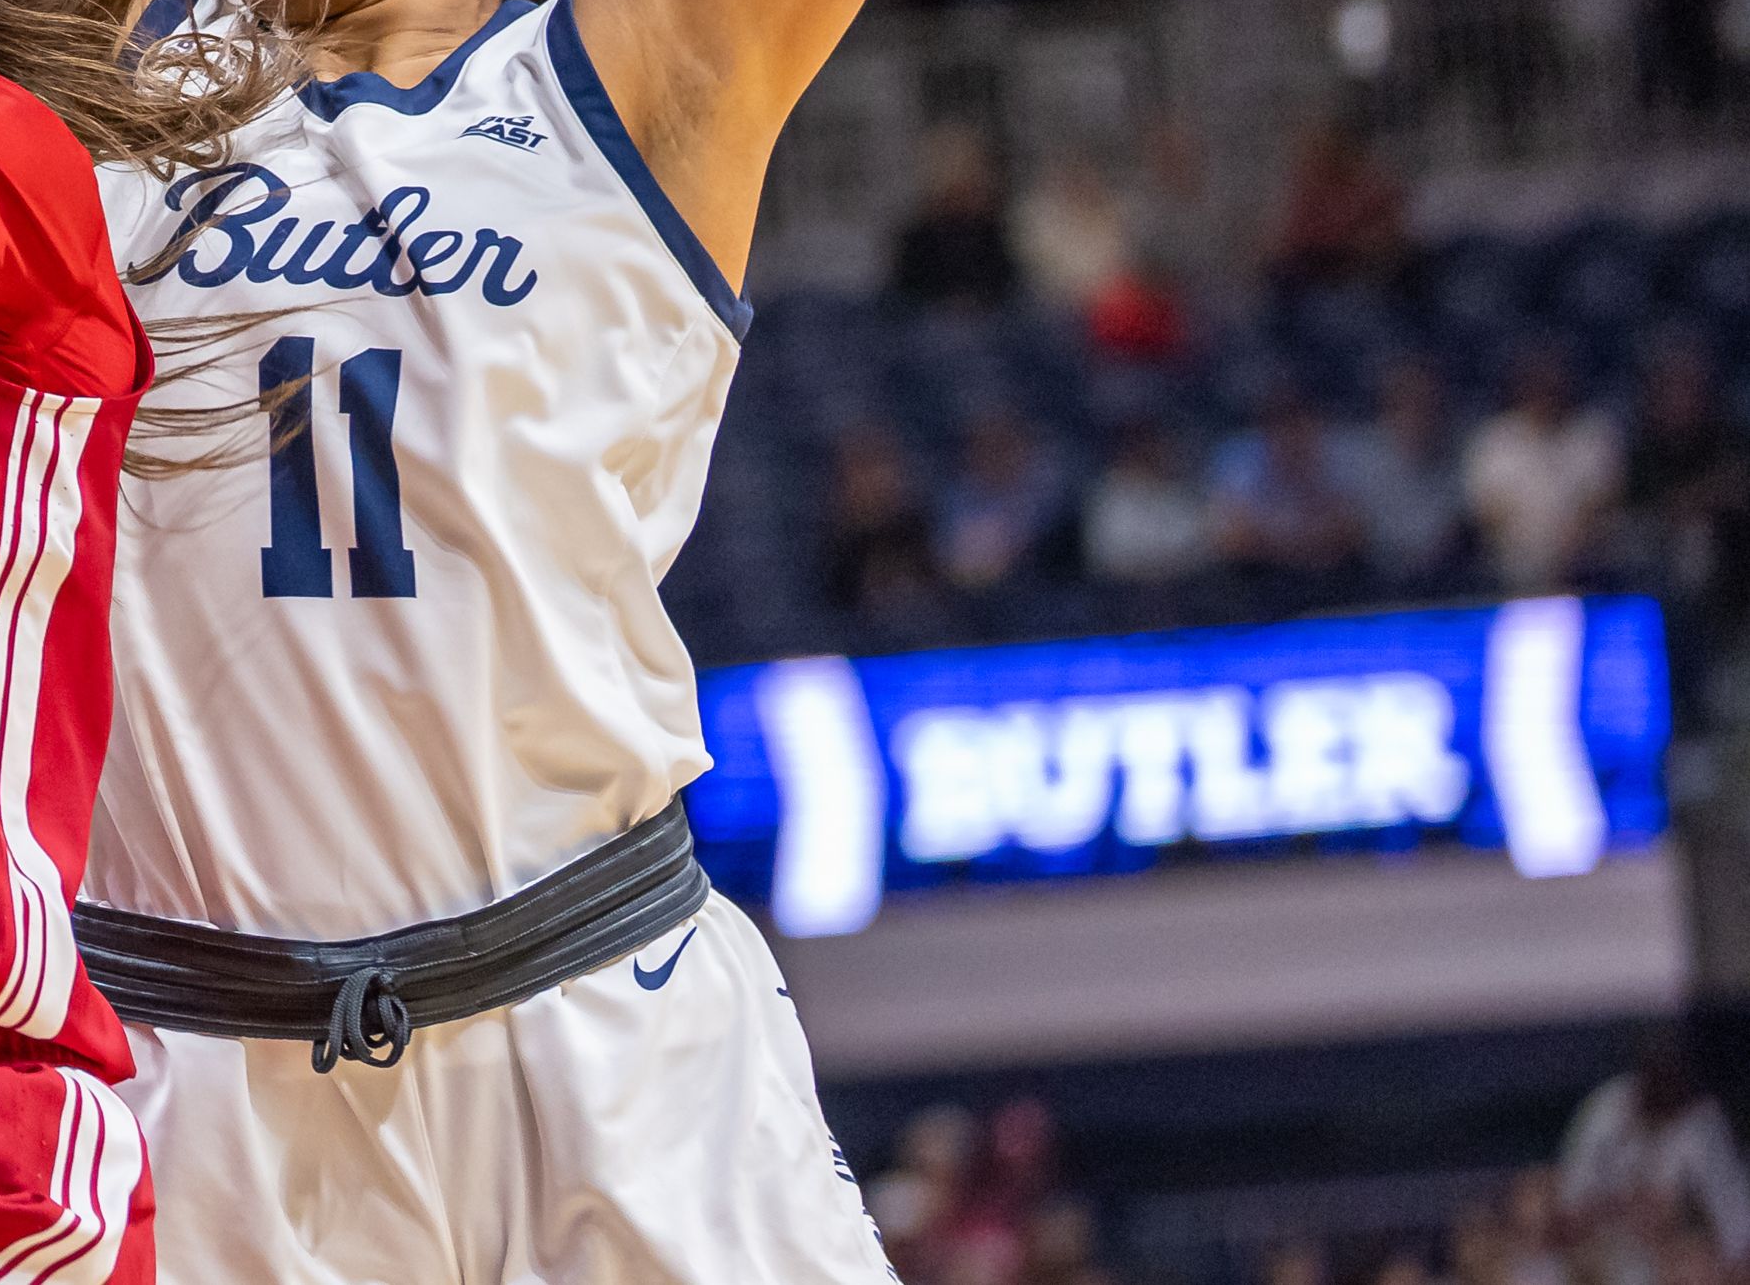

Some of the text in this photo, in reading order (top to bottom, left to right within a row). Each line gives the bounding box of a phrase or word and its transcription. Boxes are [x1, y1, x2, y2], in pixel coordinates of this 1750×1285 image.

[127, 162, 538, 307] Butler
[258, 335, 418, 599] 11
[895, 671, 1468, 863] BUTLER
